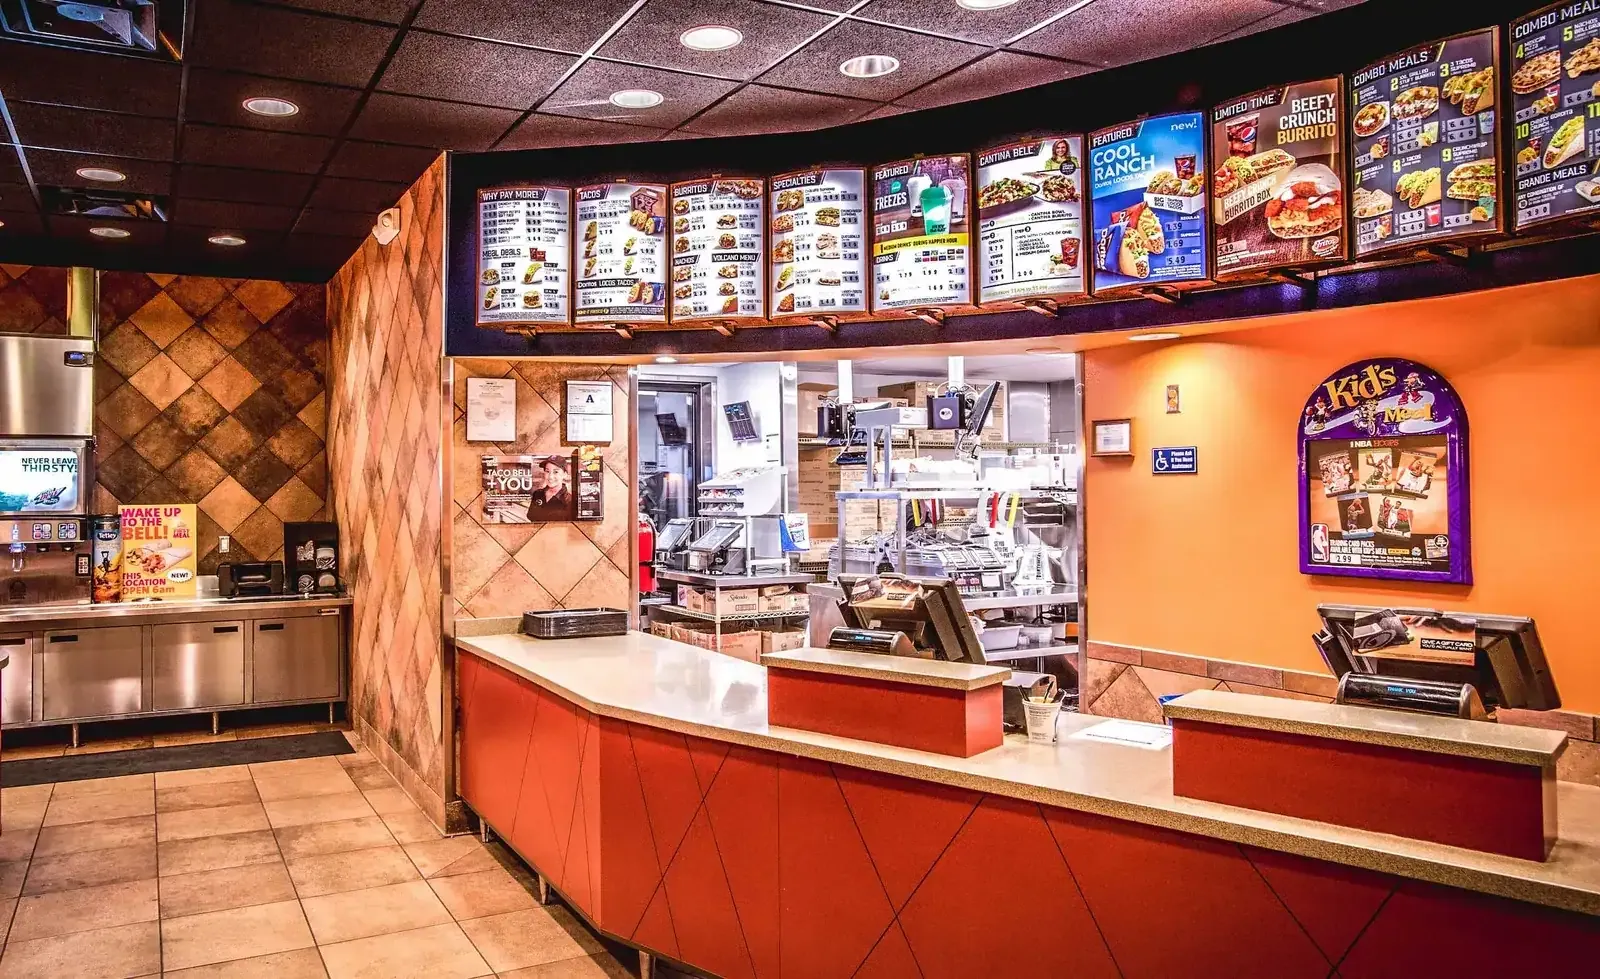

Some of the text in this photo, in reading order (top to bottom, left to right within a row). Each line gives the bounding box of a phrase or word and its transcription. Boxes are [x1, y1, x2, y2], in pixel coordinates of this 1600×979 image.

[1516, 12, 1556, 38] COMBO
[1563, 26, 1573, 42] 5
[1516, 44, 1524, 58] 4
[1353, 51, 1429, 87] COMBO MEALS
[1440, 63, 1449, 77] 3
[1391, 78, 1399, 91] 2
[1291, 93, 1336, 113] BEEFY
[1353, 93, 1359, 106] 1
[1215, 101, 1247, 121] LIMITED
[1170, 118, 1198, 131] new!
[1279, 107, 1336, 130] CRUNCH
[1093, 127, 1132, 147] FEATURED
[1277, 123, 1337, 145] BURRITO
[1516, 123, 1530, 140] 10
[980, 151, 1010, 166] CANTINA
[1093, 142, 1140, 167] COOL
[1442, 148, 1452, 162] 9
[875, 165, 909, 181] FEATURED
[1094, 154, 1155, 182] RANCH
[1392, 159, 1401, 173] 8
[773, 175, 816, 190] SPECIALTIES
[1354, 171, 1362, 185] 7
[1518, 165, 1587, 190] GRANDE MEALS
[482, 192, 498, 201] WHY
[499, 191, 515, 200] PAY
[579, 190, 601, 200] TACOS
[674, 184, 707, 196] BURRITOS
[875, 192, 907, 211] FREEZES
[1224, 188, 1272, 221] BURRITO BOX
[1168, 256, 1185, 265] 5.49
[1322, 364, 1397, 412] Kid's
[585, 395, 594, 403] A
[1383, 402, 1434, 423] Meal
[1354, 440, 1372, 448] NBA
[22, 464, 78, 473] THIRSTY!
[487, 469, 511, 477] TACO
[122, 507, 182, 518] WAKE UP
[122, 517, 162, 527] TO THE
[122, 526, 169, 541] BELL!
[1336, 555, 1352, 563] 2.99
[122, 586, 175, 595] OPEN 6am
